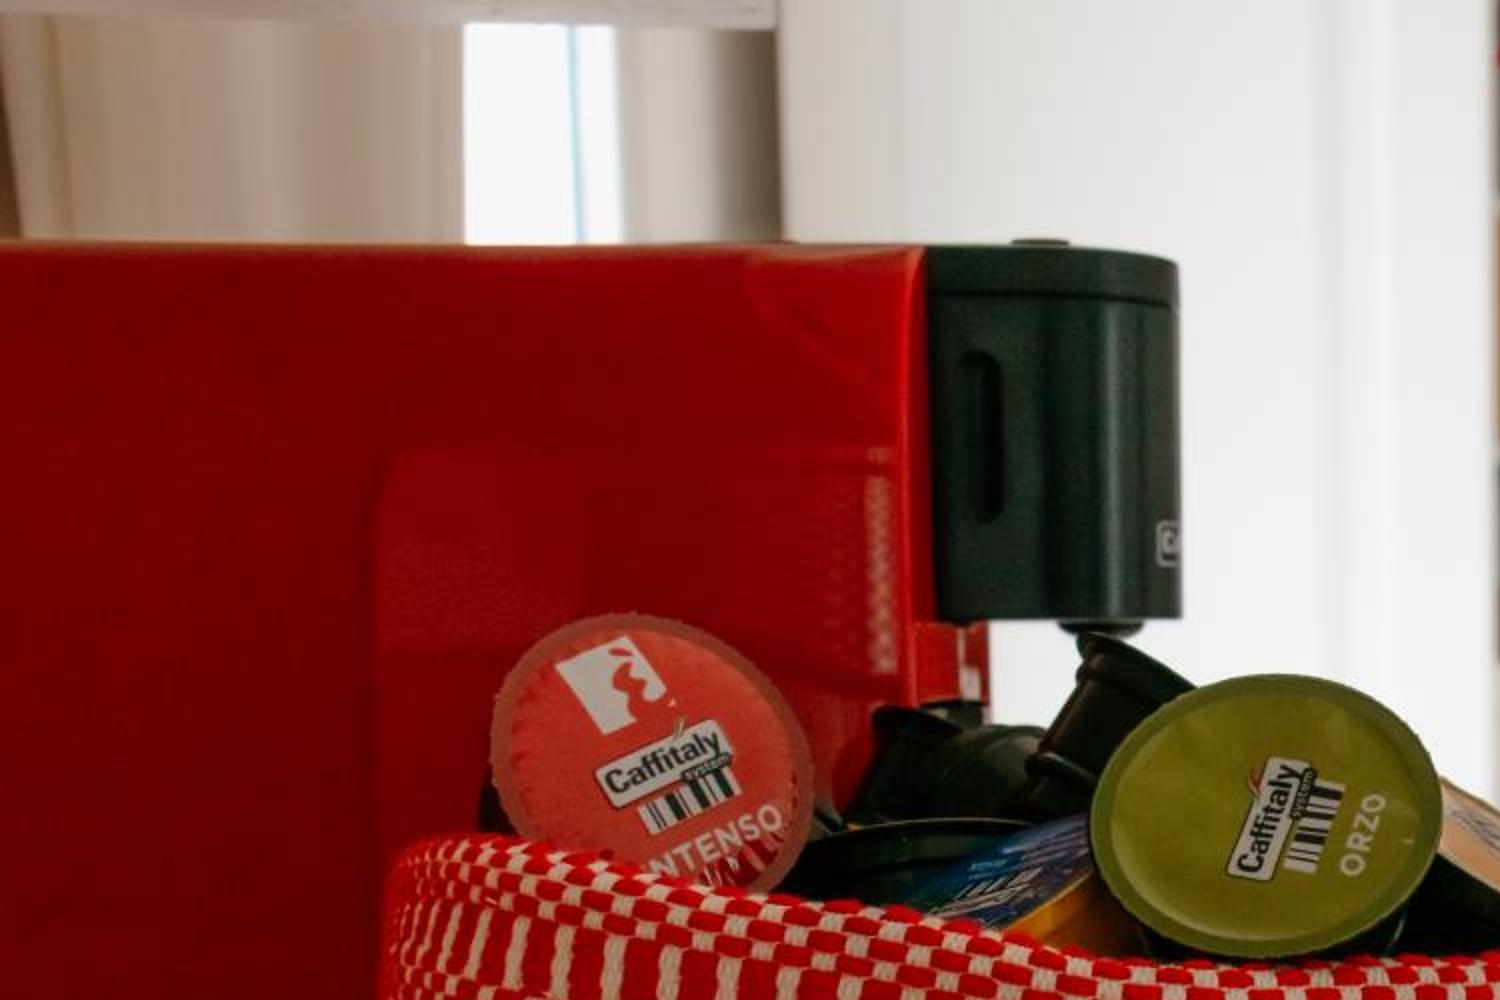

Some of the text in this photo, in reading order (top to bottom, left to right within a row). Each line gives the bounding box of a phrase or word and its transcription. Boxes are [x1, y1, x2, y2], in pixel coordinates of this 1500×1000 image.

[604, 731, 720, 795] Caffitaly
[1237, 764, 1301, 873] Caffitaly
[1339, 793, 1387, 877] ORZO
